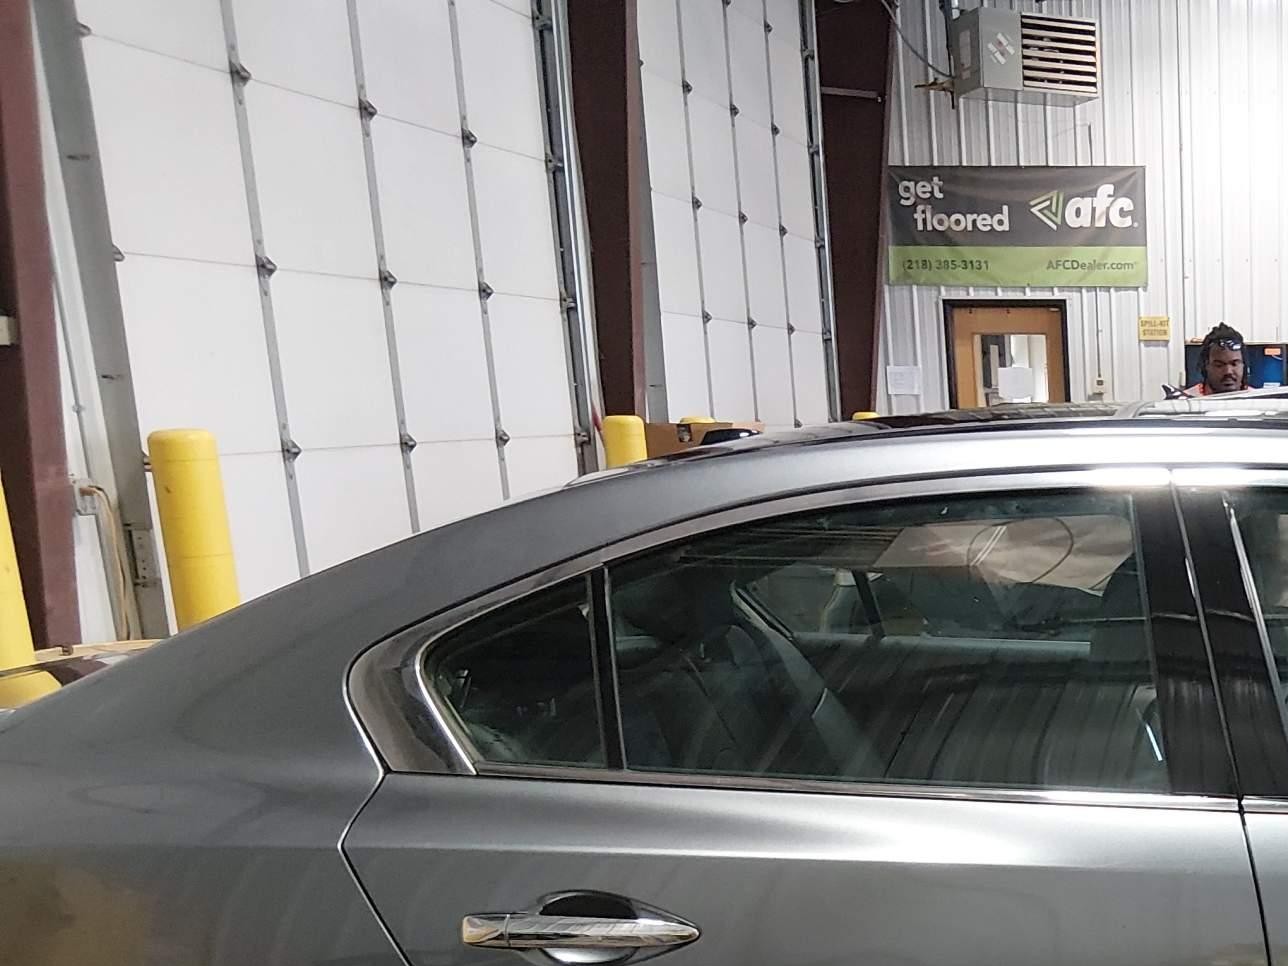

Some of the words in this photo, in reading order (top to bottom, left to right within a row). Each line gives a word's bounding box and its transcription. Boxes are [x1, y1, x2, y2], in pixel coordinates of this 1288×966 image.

[898, 176, 944, 206] get
[913, 204, 1010, 232] floored
[902, 259, 932, 272] (218)
